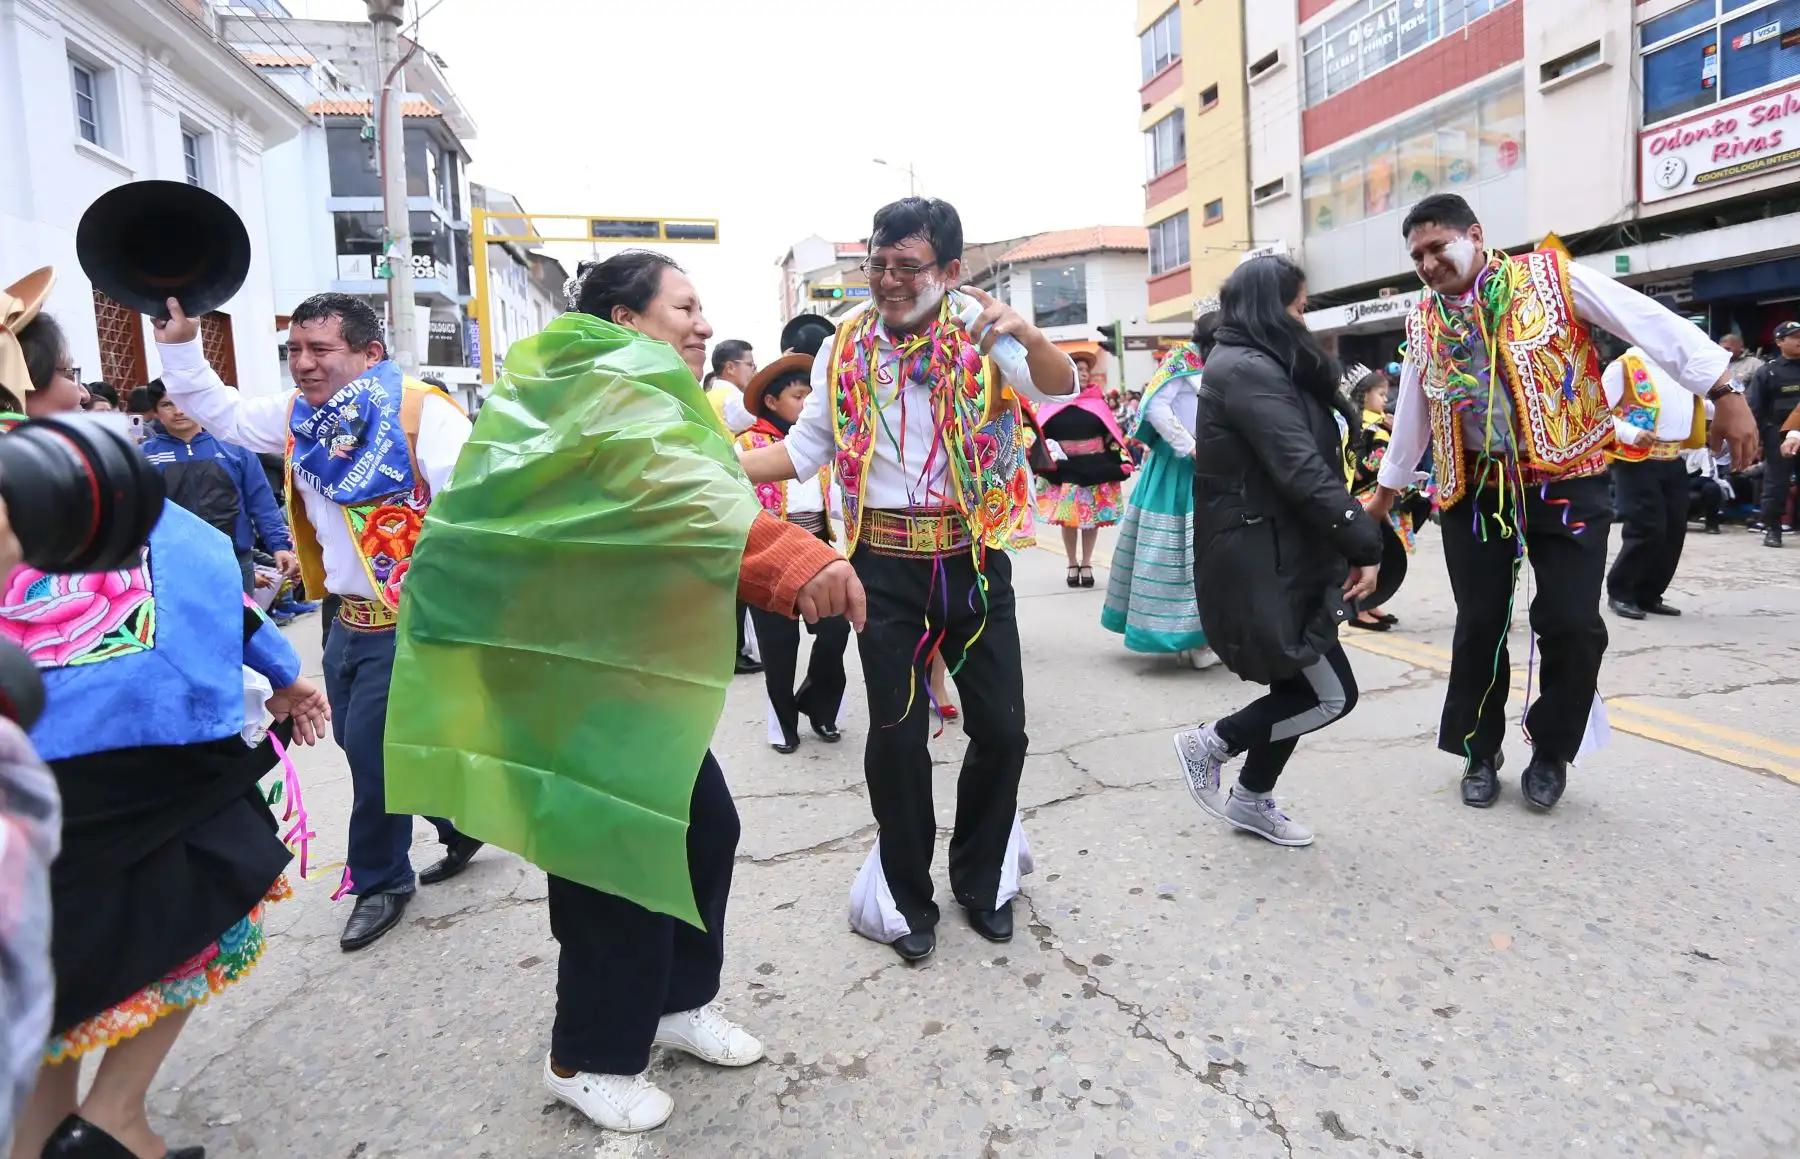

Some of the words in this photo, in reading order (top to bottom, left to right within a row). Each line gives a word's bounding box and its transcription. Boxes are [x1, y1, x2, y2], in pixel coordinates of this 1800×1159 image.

[1757, 26, 1776, 37] VISA
[1649, 118, 1738, 156] Odonto
[1711, 129, 1784, 163] Rivas
[338, 451, 375, 492] VIQUES
